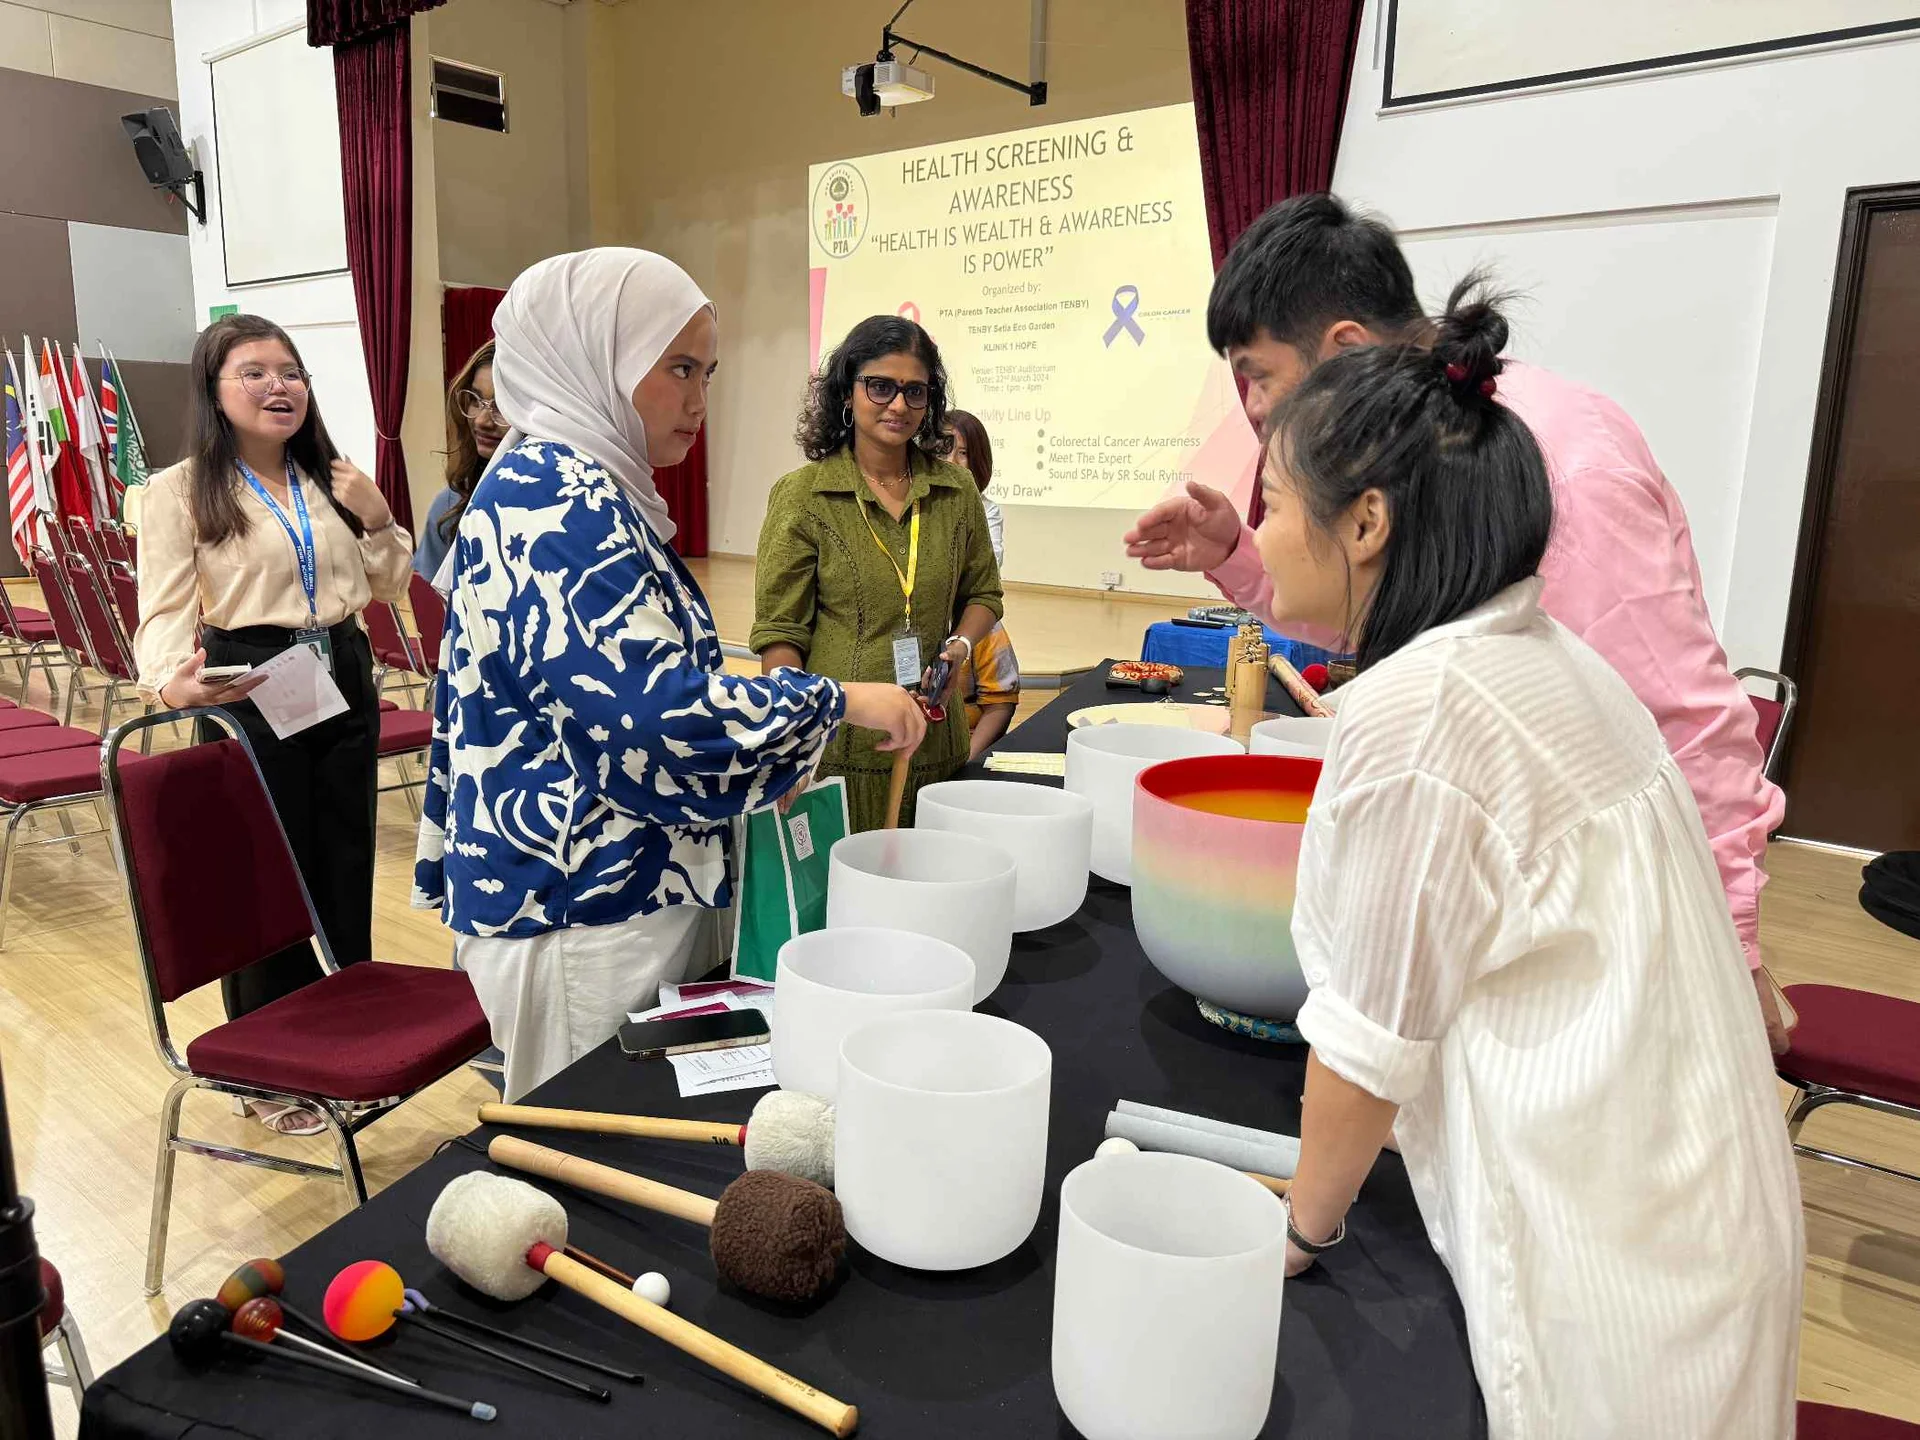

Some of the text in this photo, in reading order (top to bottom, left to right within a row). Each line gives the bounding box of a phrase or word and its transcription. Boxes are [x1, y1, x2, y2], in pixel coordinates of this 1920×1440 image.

[902, 126, 1134, 184] HEALTH SCREENING &
[948, 174, 1074, 215] AWARENESS
[944, 226, 957, 247] IS
[962, 216, 1033, 245] WEALTH
[1039, 215, 1053, 236] &
[1058, 200, 1173, 234] AWARENESS
[833, 240, 849, 254] PTA
[963, 254, 977, 275] IS
[982, 282, 1042, 298] Organized by:
[939, 299, 1090, 319] PTA (Parents Teacher Association TENBY)
[1162, 308, 1191, 316] CANCER
[968, 325, 992, 335] TENBY
[1013, 322, 1027, 332] Eco
[1028, 321, 1056, 331] Garden
[983, 342, 1008, 352] KLINIK
[1015, 340, 1038, 351] HOPE
[976, 407, 1052, 424] tivity Line Up
[1049, 435, 1201, 447] Colorectal Cancer Awareness
[1049, 452, 1133, 466] Meet The Expert
[1048, 468, 1078, 480] Sound
[1080, 468, 1099, 480] SPA
[1101, 469, 1115, 482] by
[1117, 469, 1131, 481] SR
[1133, 470, 1156, 482] Soul
[306, 544, 314, 572] SCHOOLS
